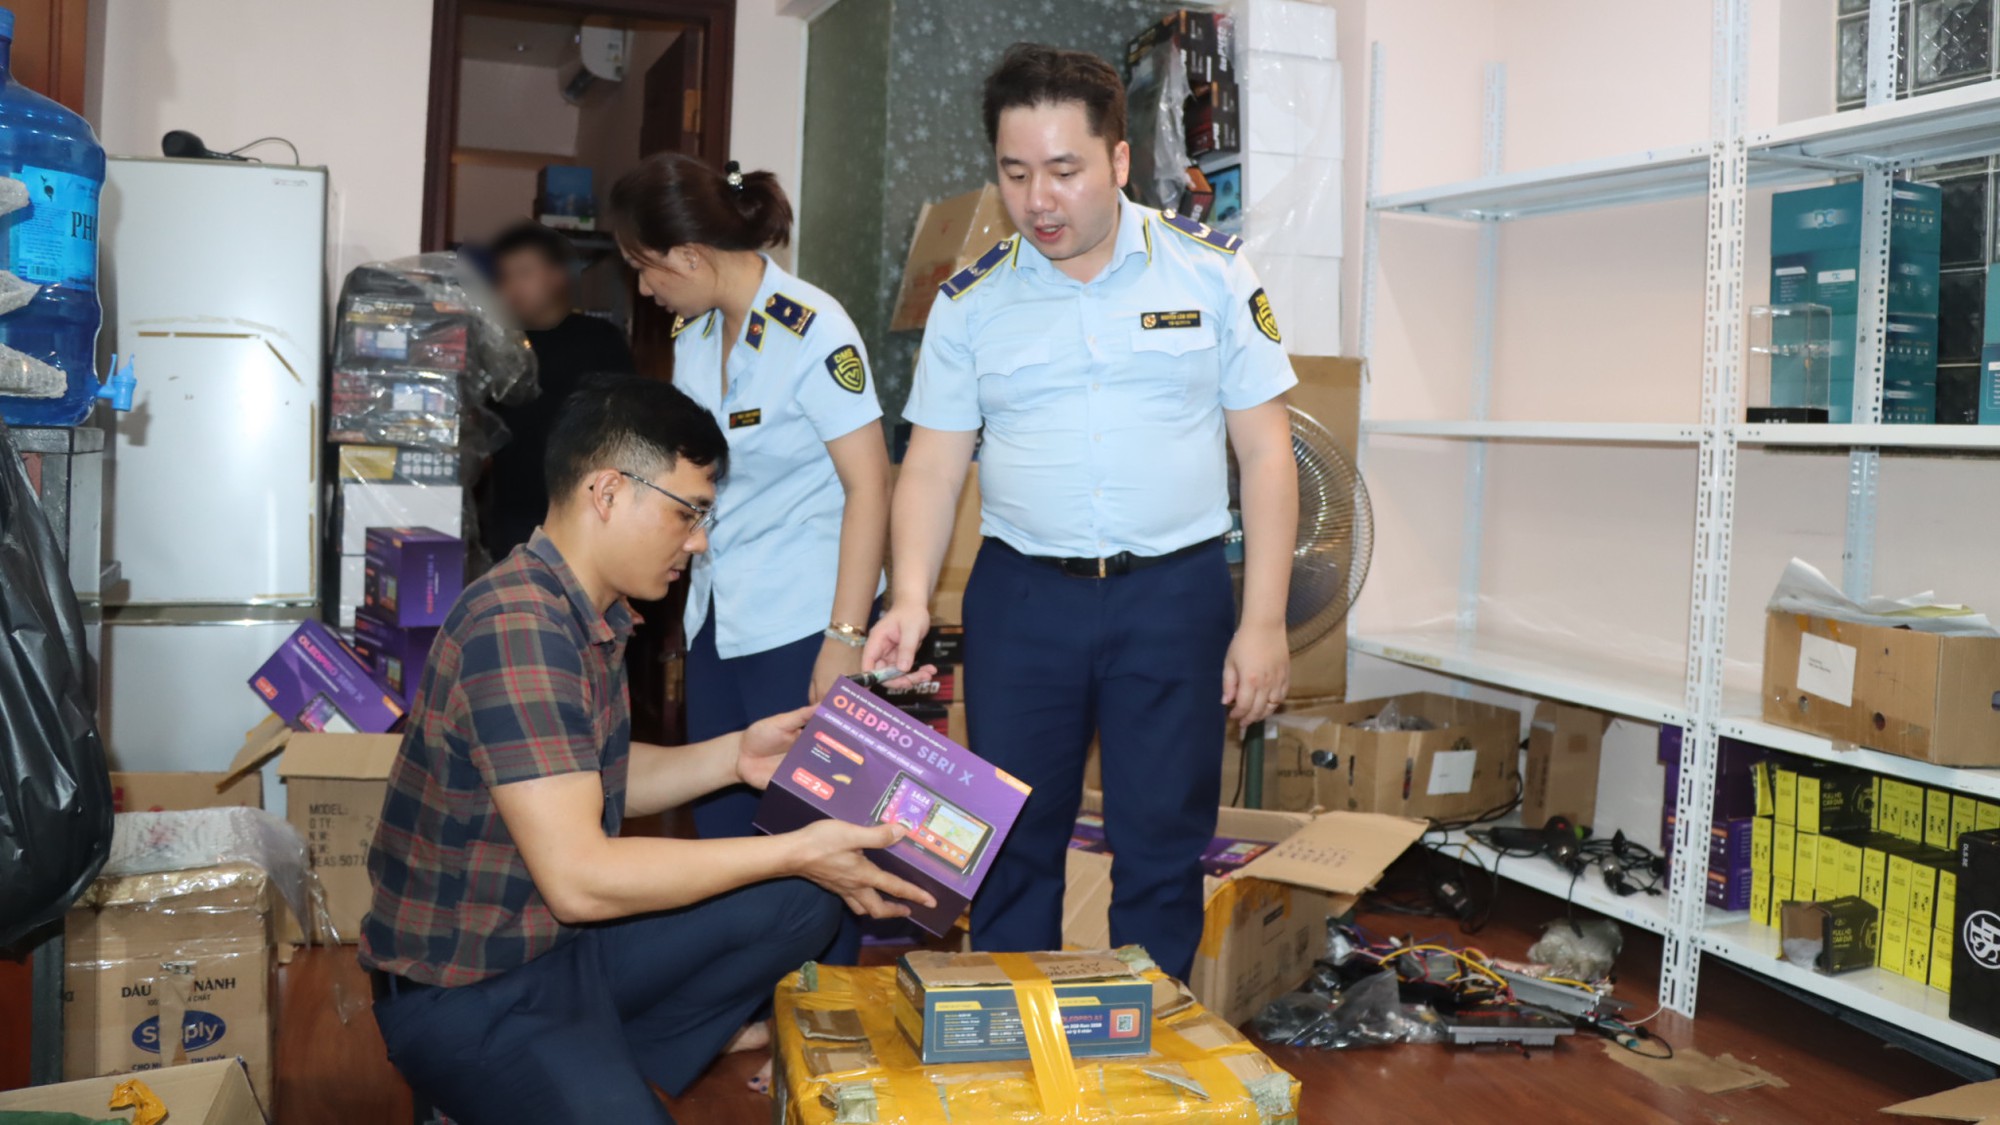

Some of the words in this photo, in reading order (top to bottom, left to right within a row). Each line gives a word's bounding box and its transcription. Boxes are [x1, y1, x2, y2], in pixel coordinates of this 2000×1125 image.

[298, 634, 338, 677] OLEDPRO
[833, 694, 913, 749] OLEDPRO
[917, 745, 954, 775] SERI
[959, 772, 974, 786] X
[811, 781, 821, 791] 2
[194, 978, 236, 992] NÀNH
[142, 1021, 218, 1044] Sply
